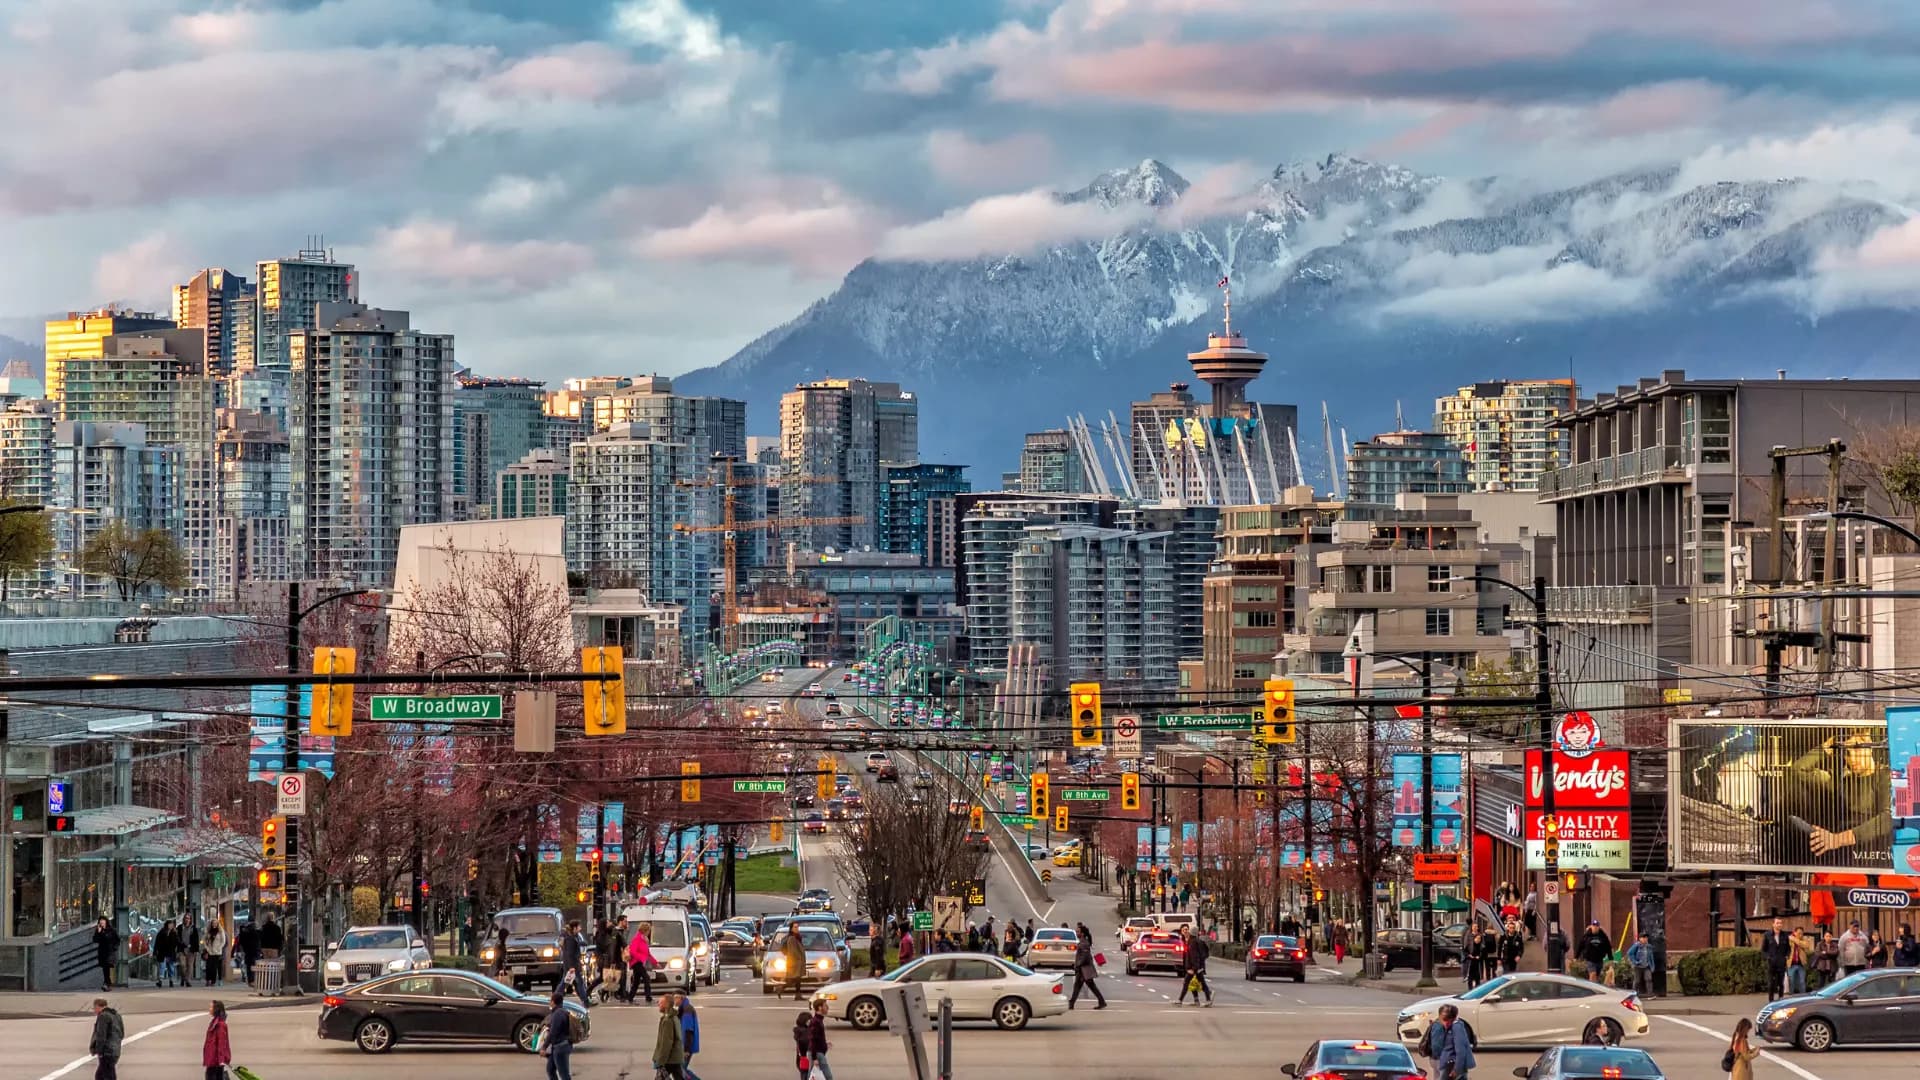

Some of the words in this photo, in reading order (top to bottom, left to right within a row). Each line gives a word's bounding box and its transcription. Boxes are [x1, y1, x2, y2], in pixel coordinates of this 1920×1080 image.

[383, 699, 398, 714] W
[406, 698, 491, 717] Broadway
[1165, 716, 1178, 727] W
[1183, 715, 1246, 729] Broadway
[1531, 758, 1626, 799] Wendy's
[737, 783, 746, 791] W
[749, 783, 764, 791] 8th
[766, 783, 782, 791] Ave
[1065, 791, 1073, 799] W
[1091, 791, 1106, 799] Ave
[1567, 842, 1592, 850] HIRING
[1562, 850, 1580, 858] TIME
[1581, 850, 1600, 858] FULL
[1604, 850, 1622, 858] TIME
[1852, 850, 1894, 861] YALETOW
[1852, 892, 1905, 905] PATTISON
